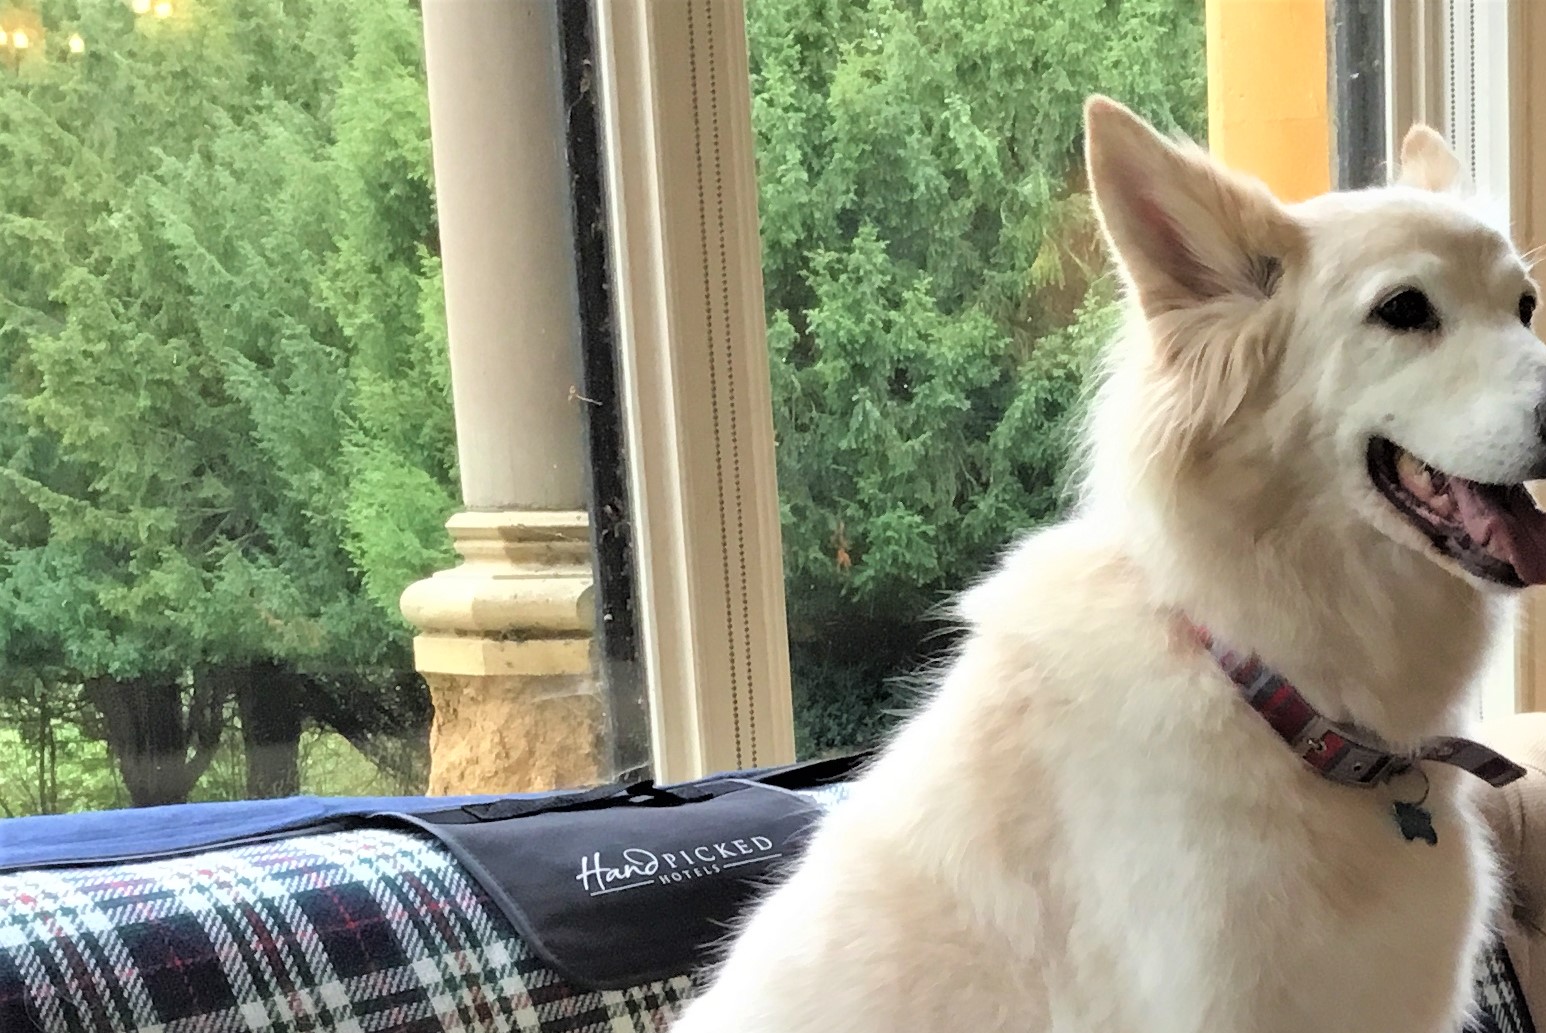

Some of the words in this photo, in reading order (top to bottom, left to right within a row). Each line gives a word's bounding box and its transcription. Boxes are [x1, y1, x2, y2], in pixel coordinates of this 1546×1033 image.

[576, 848, 658, 890] Hand
[661, 836, 773, 868] PICKED
[658, 863, 721, 884] HOTELS
